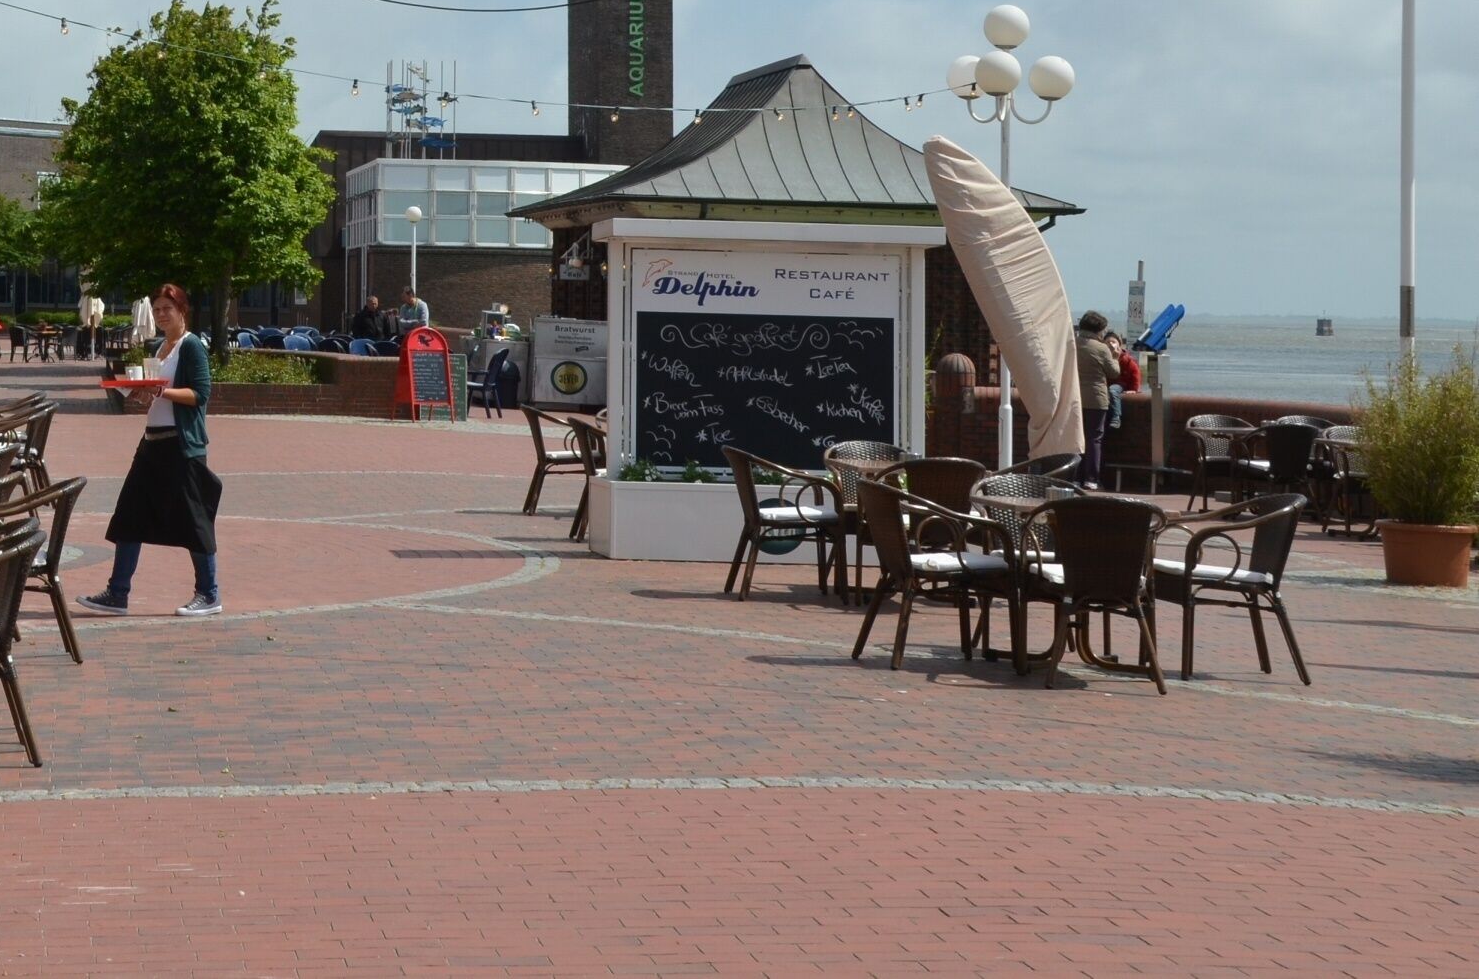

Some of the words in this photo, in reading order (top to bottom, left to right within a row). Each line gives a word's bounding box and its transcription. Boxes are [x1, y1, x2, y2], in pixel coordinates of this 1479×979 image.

[774, 268, 890, 282] RESTAURANT
[652, 271, 761, 306] Delphin
[809, 287, 855, 300] CAFÉ
[554, 325, 595, 334] Bratwurst
[690, 322, 731, 347] Café
[825, 400, 865, 423] Kuchen
